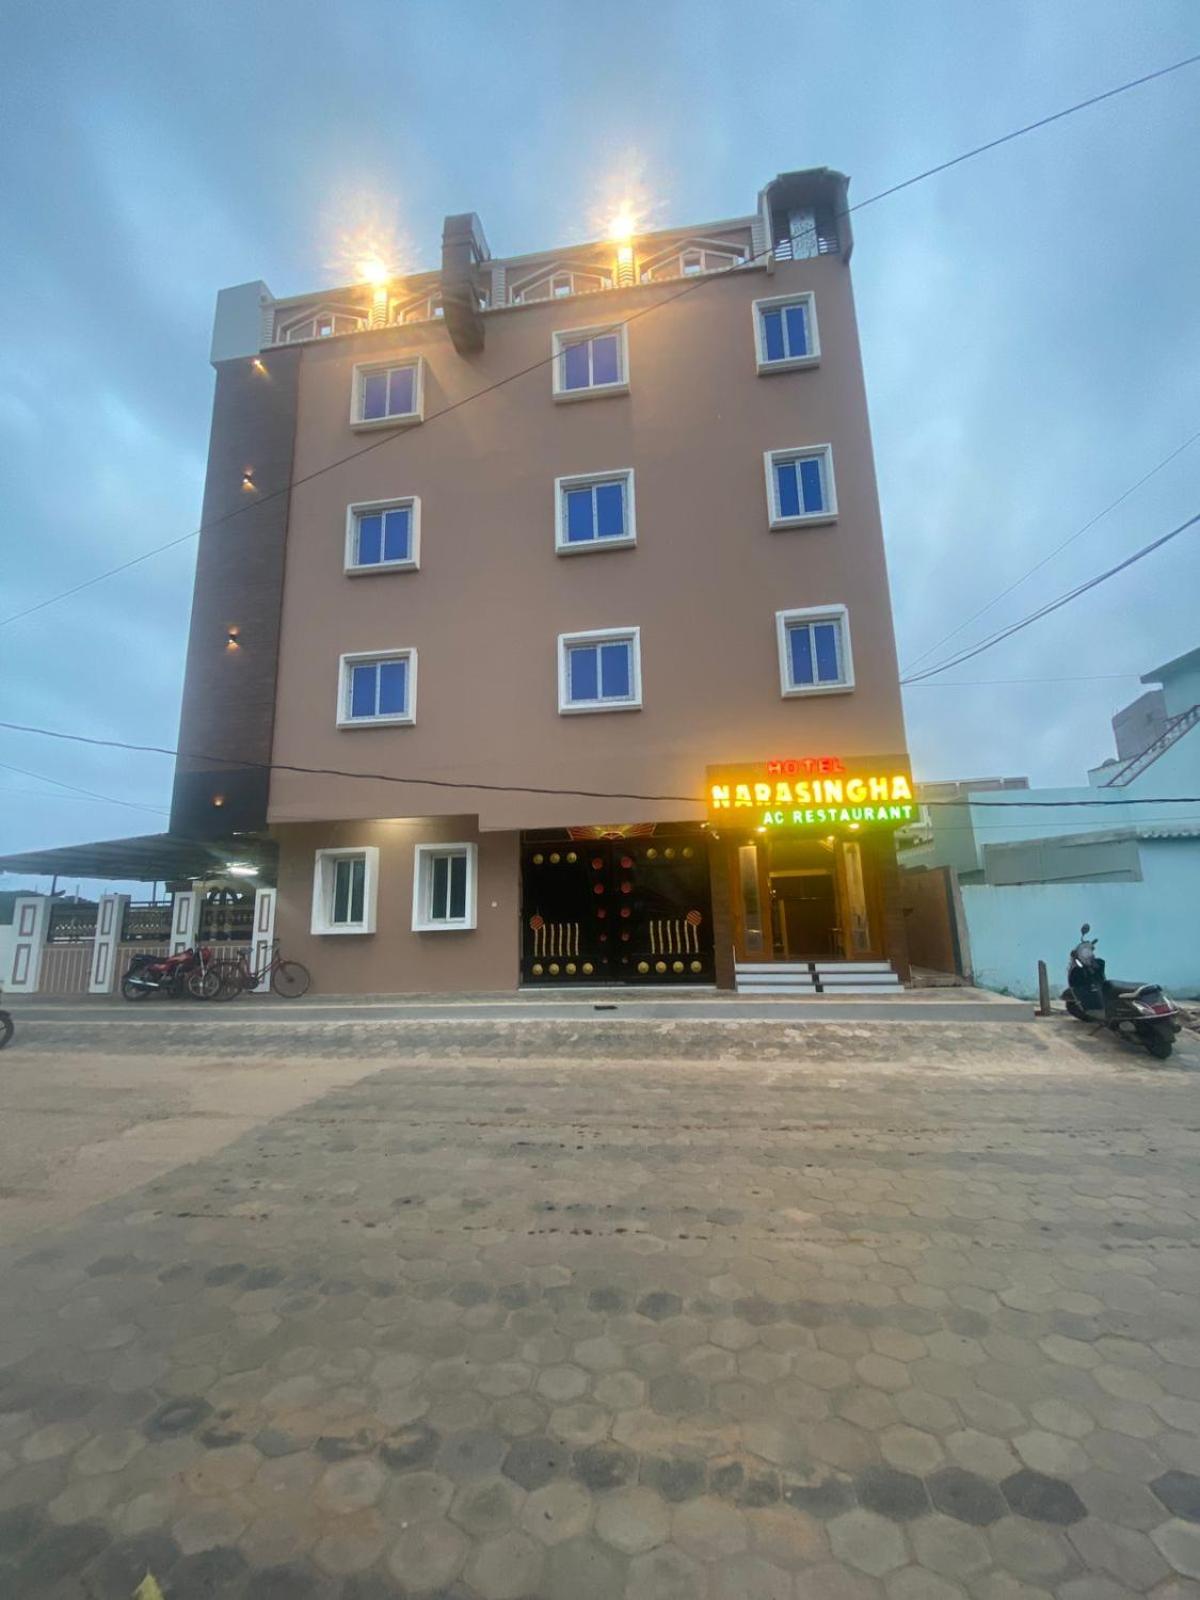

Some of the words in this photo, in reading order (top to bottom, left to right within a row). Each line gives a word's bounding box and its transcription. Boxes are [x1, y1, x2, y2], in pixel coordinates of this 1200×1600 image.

[767, 757, 845, 776] HOTEL
[711, 776, 912, 808] NARASINGHA
[763, 810, 784, 824] AC
[793, 806, 912, 824] RESTAURANT
